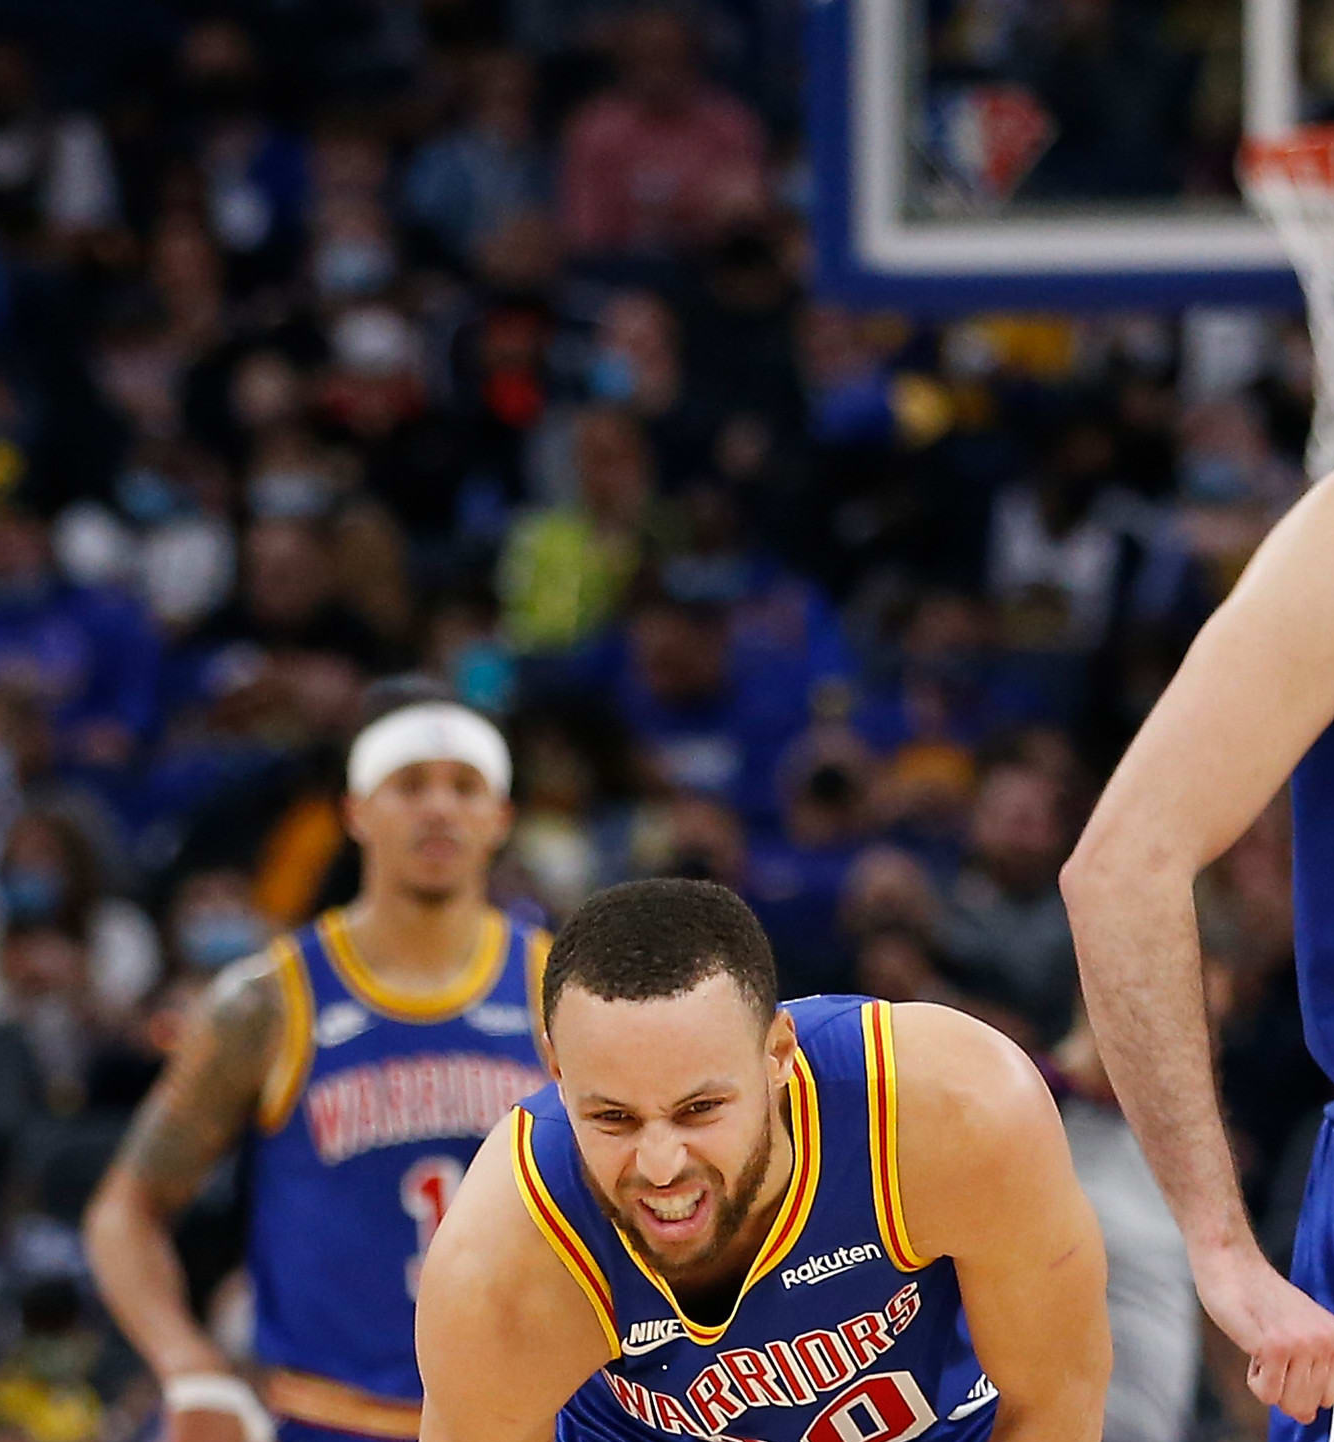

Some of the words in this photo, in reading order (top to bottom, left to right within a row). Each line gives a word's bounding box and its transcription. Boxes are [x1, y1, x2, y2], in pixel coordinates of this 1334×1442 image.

[781, 1242, 882, 1290] Rakuten
[629, 1319, 682, 1345] NIKE
[602, 1281, 922, 1438] WARRIORS
